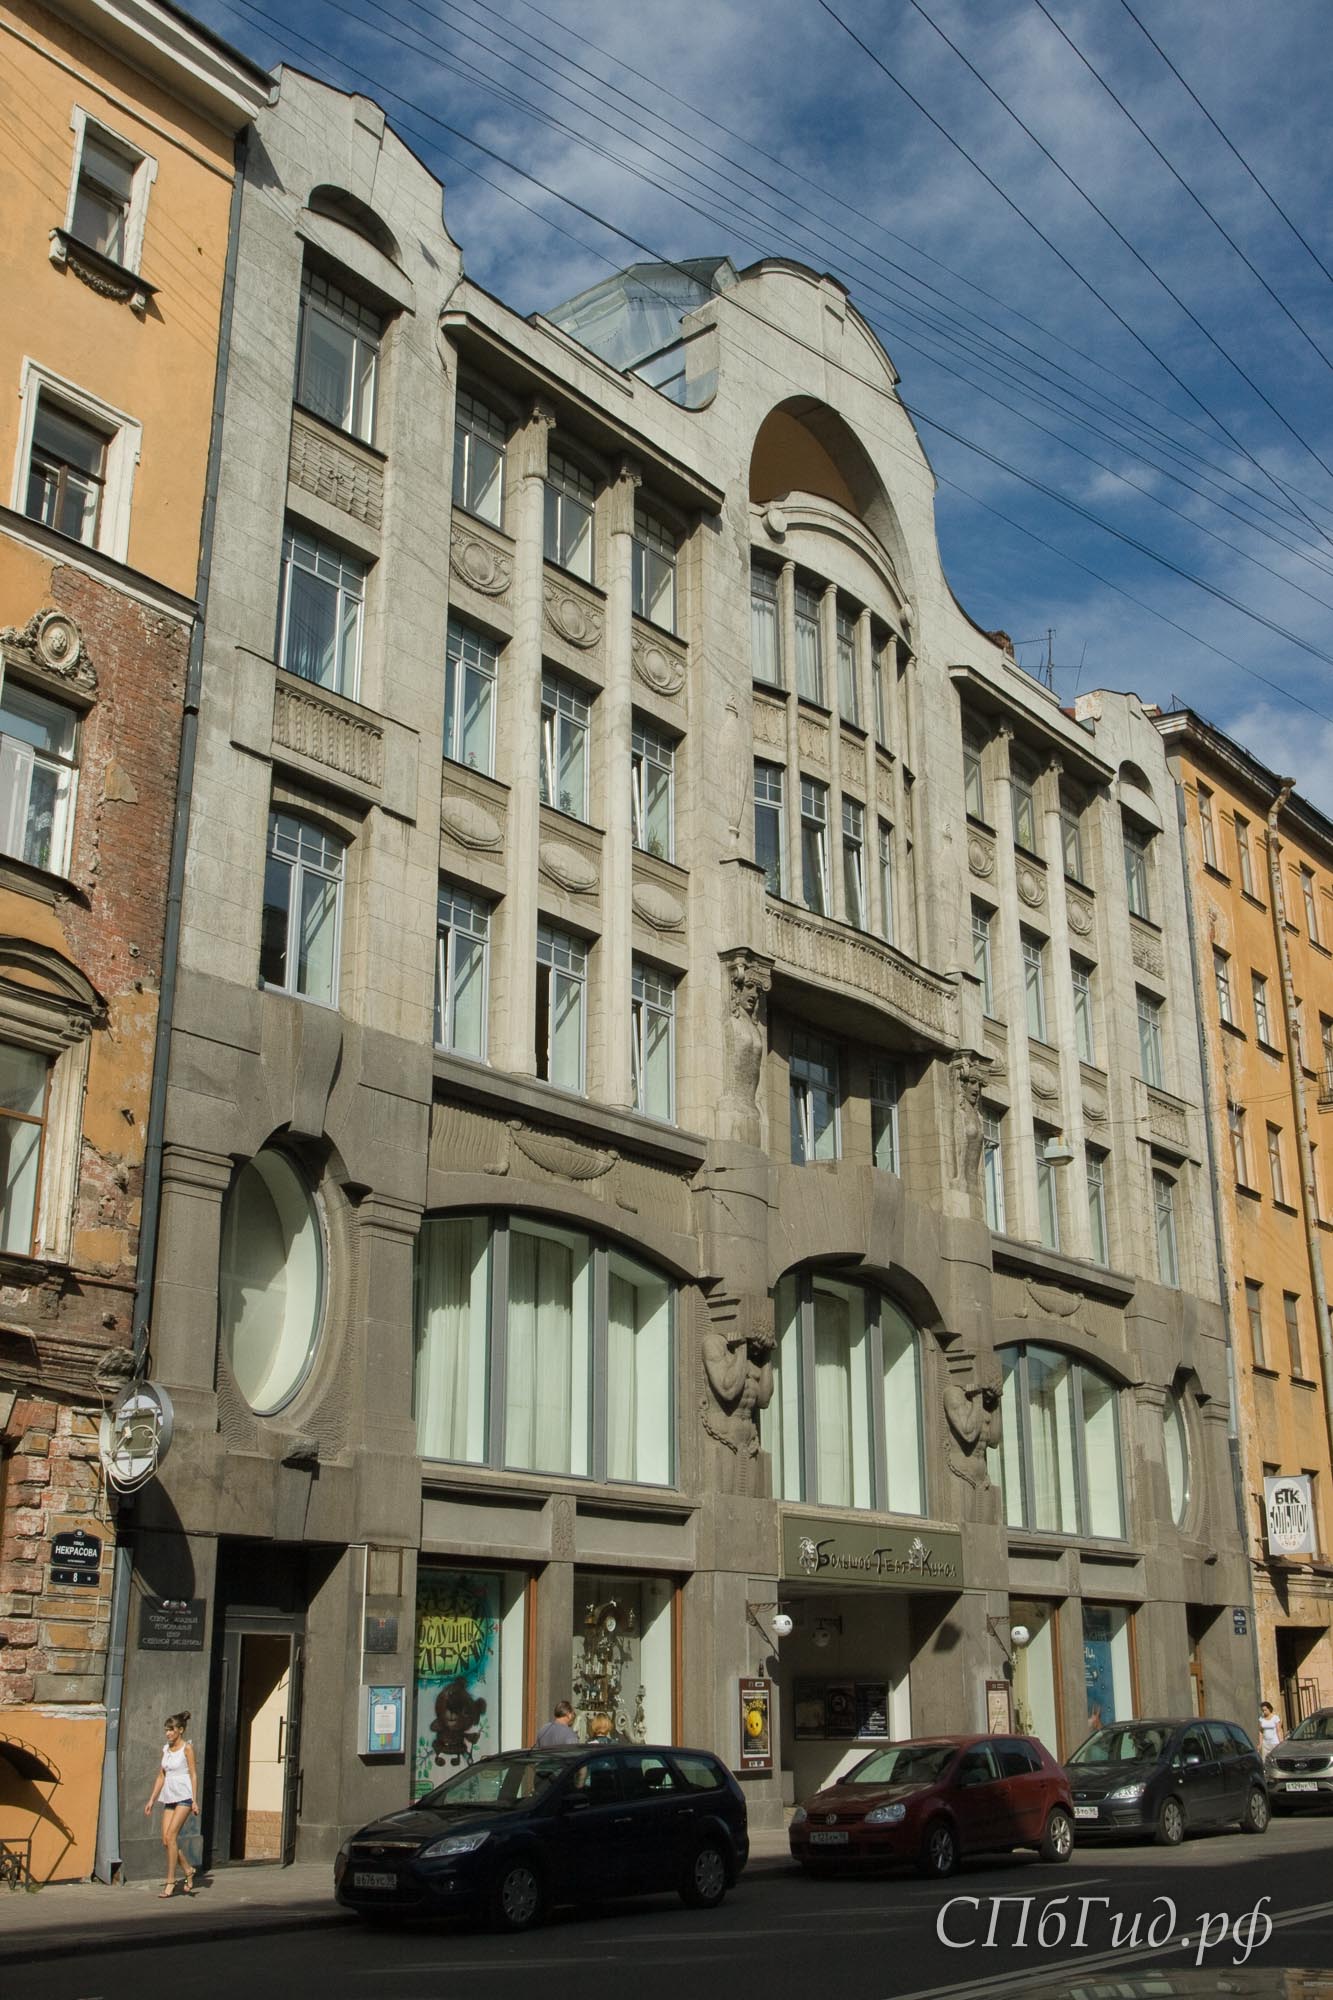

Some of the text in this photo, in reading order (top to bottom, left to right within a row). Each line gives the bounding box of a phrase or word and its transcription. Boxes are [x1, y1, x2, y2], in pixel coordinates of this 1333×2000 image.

[1275, 1488, 1300, 1505] БТК
[55, 1545, 98, 1557] НЕКРАСОВА
[73, 1572, 78, 1582] 8
